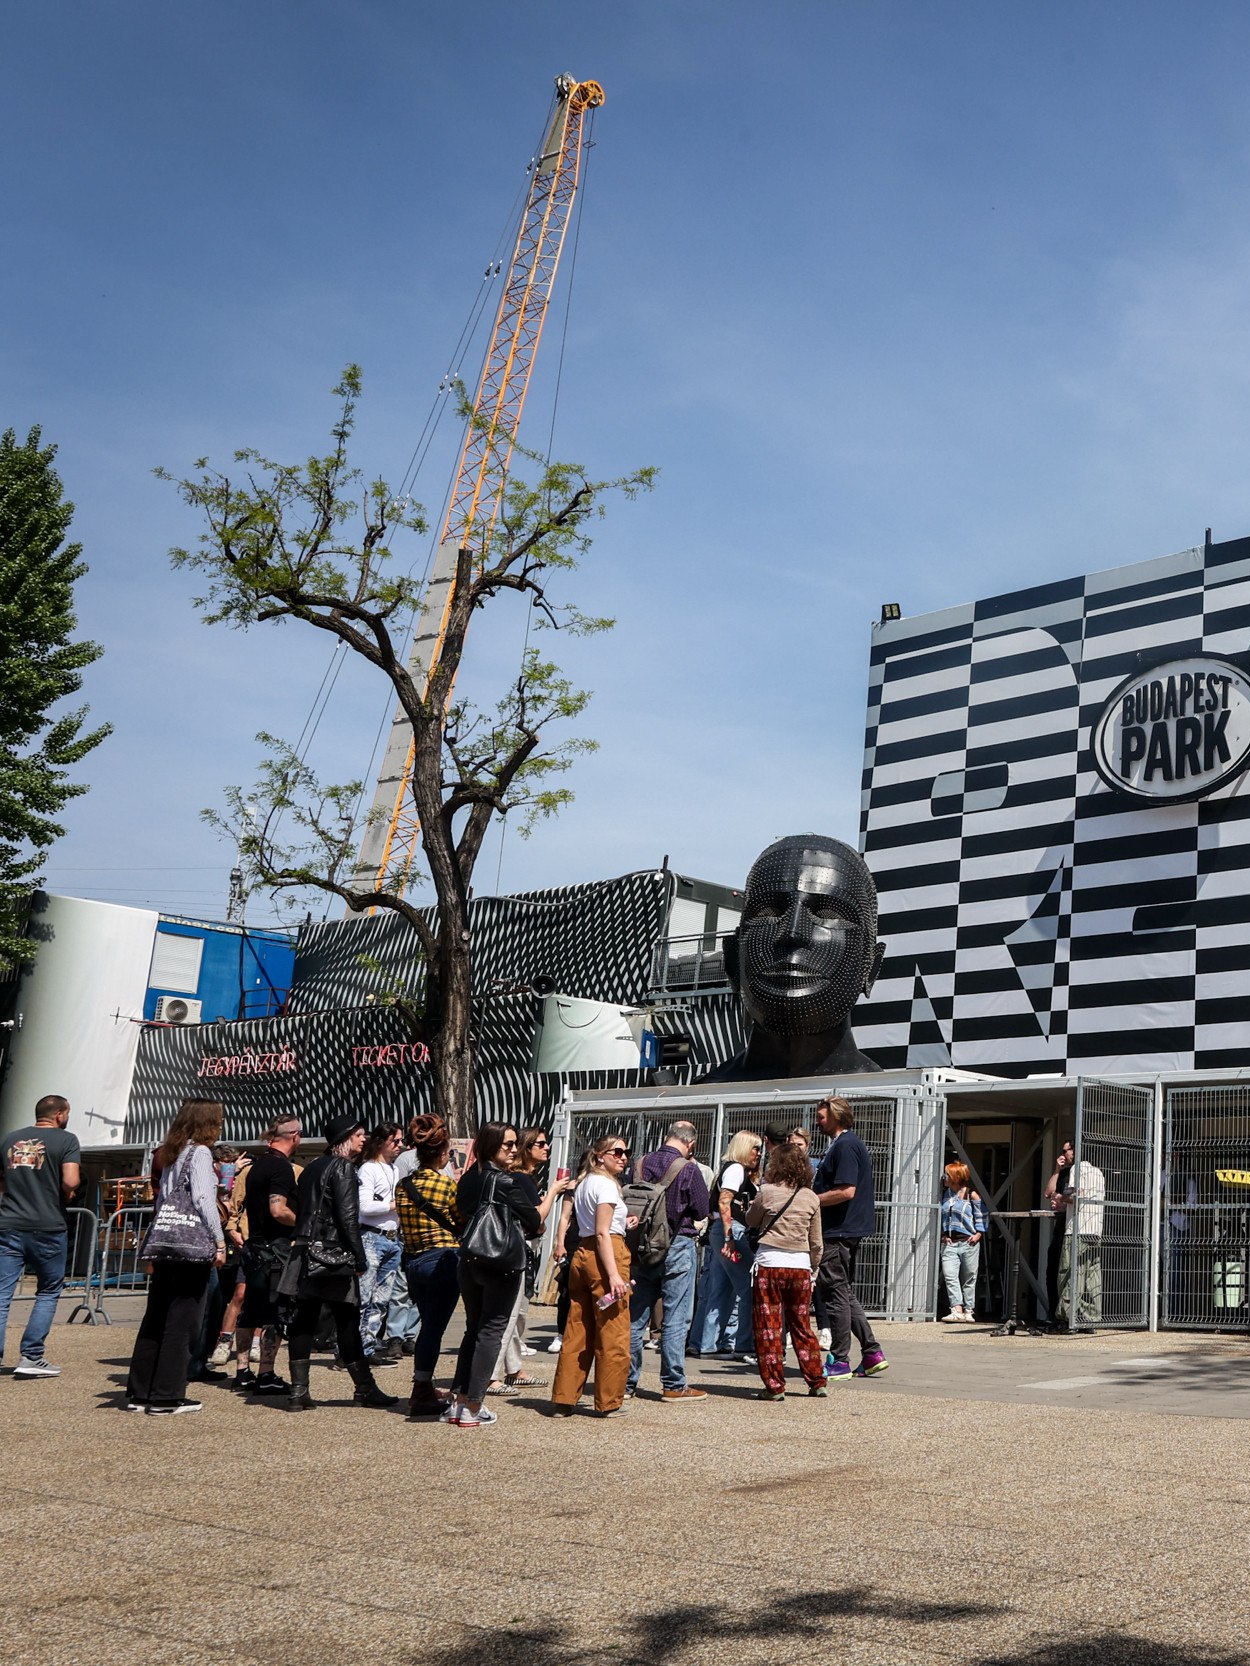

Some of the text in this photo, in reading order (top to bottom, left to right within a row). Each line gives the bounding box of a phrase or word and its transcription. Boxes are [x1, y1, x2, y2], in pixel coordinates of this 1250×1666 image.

[1122, 672, 1232, 727] BUDAPEST
[1121, 709, 1232, 782] PARK
[197, 1045, 297, 1078] JEGYPÉNZTÁR
[352, 1043, 409, 1067] TICKET
[156, 1217, 196, 1228] shopping
